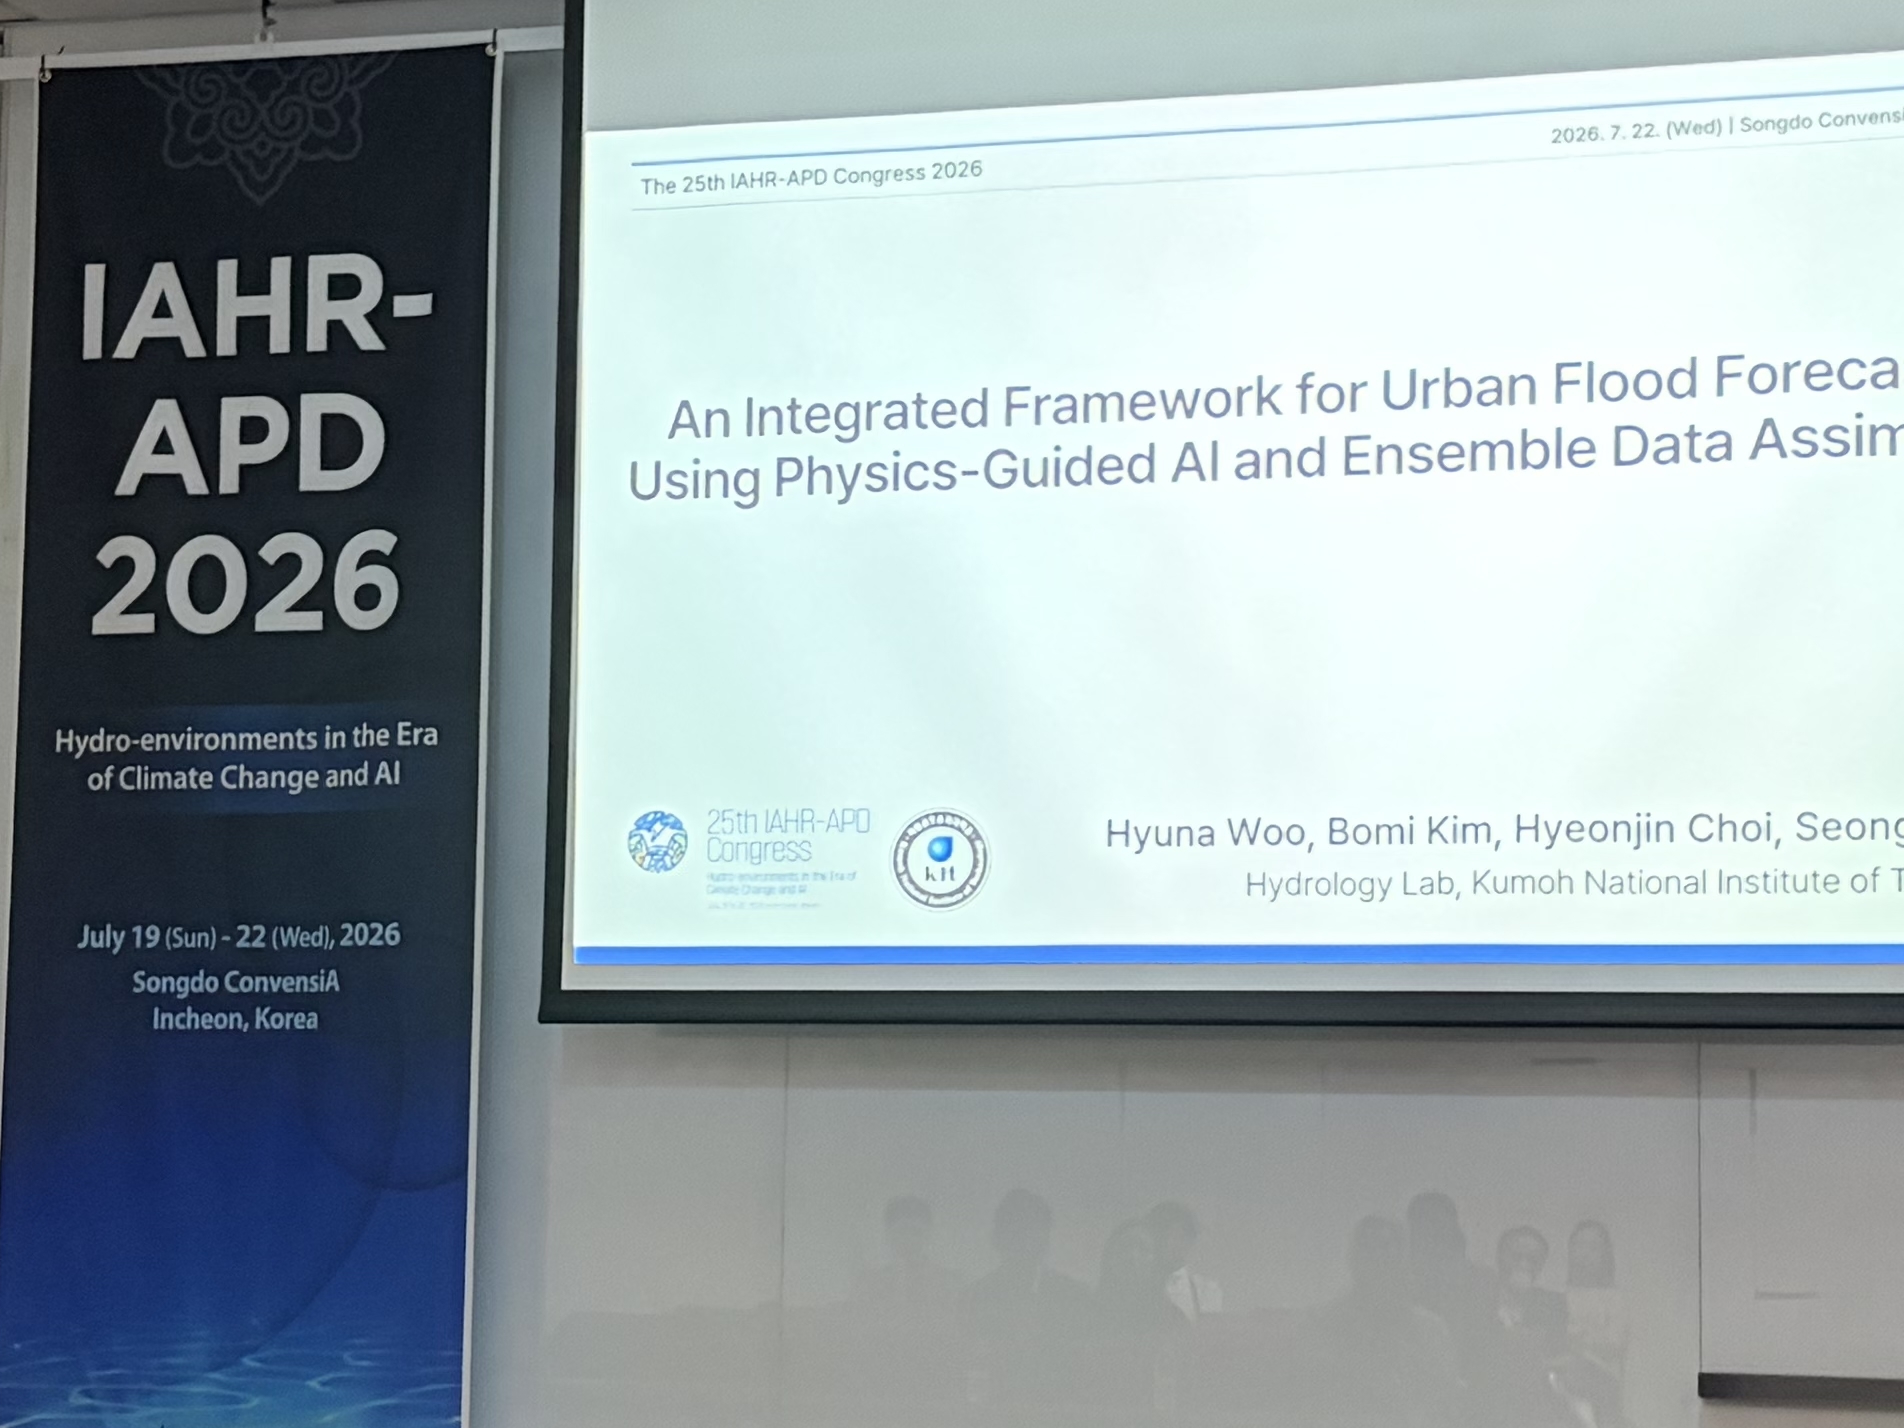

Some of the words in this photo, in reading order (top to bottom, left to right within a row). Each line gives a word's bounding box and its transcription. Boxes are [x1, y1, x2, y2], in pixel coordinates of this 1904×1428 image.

[1552, 126, 1605, 145] 2026.
[1610, 125, 1628, 142] 7.
[1632, 122, 1660, 141] 22.
[1666, 118, 1723, 141] (Wed)
[1740, 113, 1813, 137] Songdo
[641, 177, 677, 197] The
[682, 173, 726, 194] 25th
[730, 166, 829, 190] IAHR-APD
[833, 162, 926, 188] Congress
[931, 159, 983, 181] 2026
[82, 253, 433, 360] IAHR-
[667, 399, 731, 440] An
[744, 387, 989, 445] Integrated
[1003, 375, 1283, 429] Framework
[1295, 371, 1369, 414] for
[1382, 367, 1538, 412] Urban
[1554, 355, 1699, 404] Flood
[114, 393, 386, 496] APD
[628, 457, 761, 511] Using
[775, 442, 1158, 506] Physics-Guided
[1170, 440, 1220, 484] AI
[1233, 435, 1328, 481] and
[1343, 427, 1598, 479] Ensemble
[1612, 423, 1734, 468] Data
[91, 528, 399, 635] 2026
[55, 726, 317, 760] Hydro-environments
[324, 725, 346, 749] in
[352, 724, 390, 749] the
[397, 722, 438, 747] Era
[87, 765, 114, 790] of
[119, 766, 213, 790] Climate
[220, 764, 319, 795] Change
[326, 762, 369, 787] and
[374, 761, 401, 785] AI
[707, 809, 758, 834] 25th
[1105, 818, 1215, 855] Hyuna
[1226, 818, 1315, 854] Woo,
[1328, 816, 1415, 846] Bomi
[1427, 816, 1502, 852] Kim,
[1514, 812, 1675, 851] Hyeonjin
[1688, 812, 1782, 850] Choi,
[707, 836, 813, 865] Congress
[1245, 872, 1393, 902] Hydrology
[1402, 871, 1462, 901] Lab,
[1472, 870, 1574, 895] Kumoh
[1584, 869, 1707, 895] National
[1718, 868, 1841, 894] Institute
[1849, 866, 1881, 893] of
[77, 924, 125, 955] July
[132, 925, 160, 948] 19
[165, 926, 216, 951] (Sun)
[236, 925, 266, 949] 22
[272, 926, 335, 952] (Wed),
[340, 922, 401, 946] 2026
[132, 971, 219, 999] Songdo
[224, 969, 340, 993] ConvensiA
[153, 1007, 249, 1033] Incheon,
[255, 1007, 318, 1031] Korea
